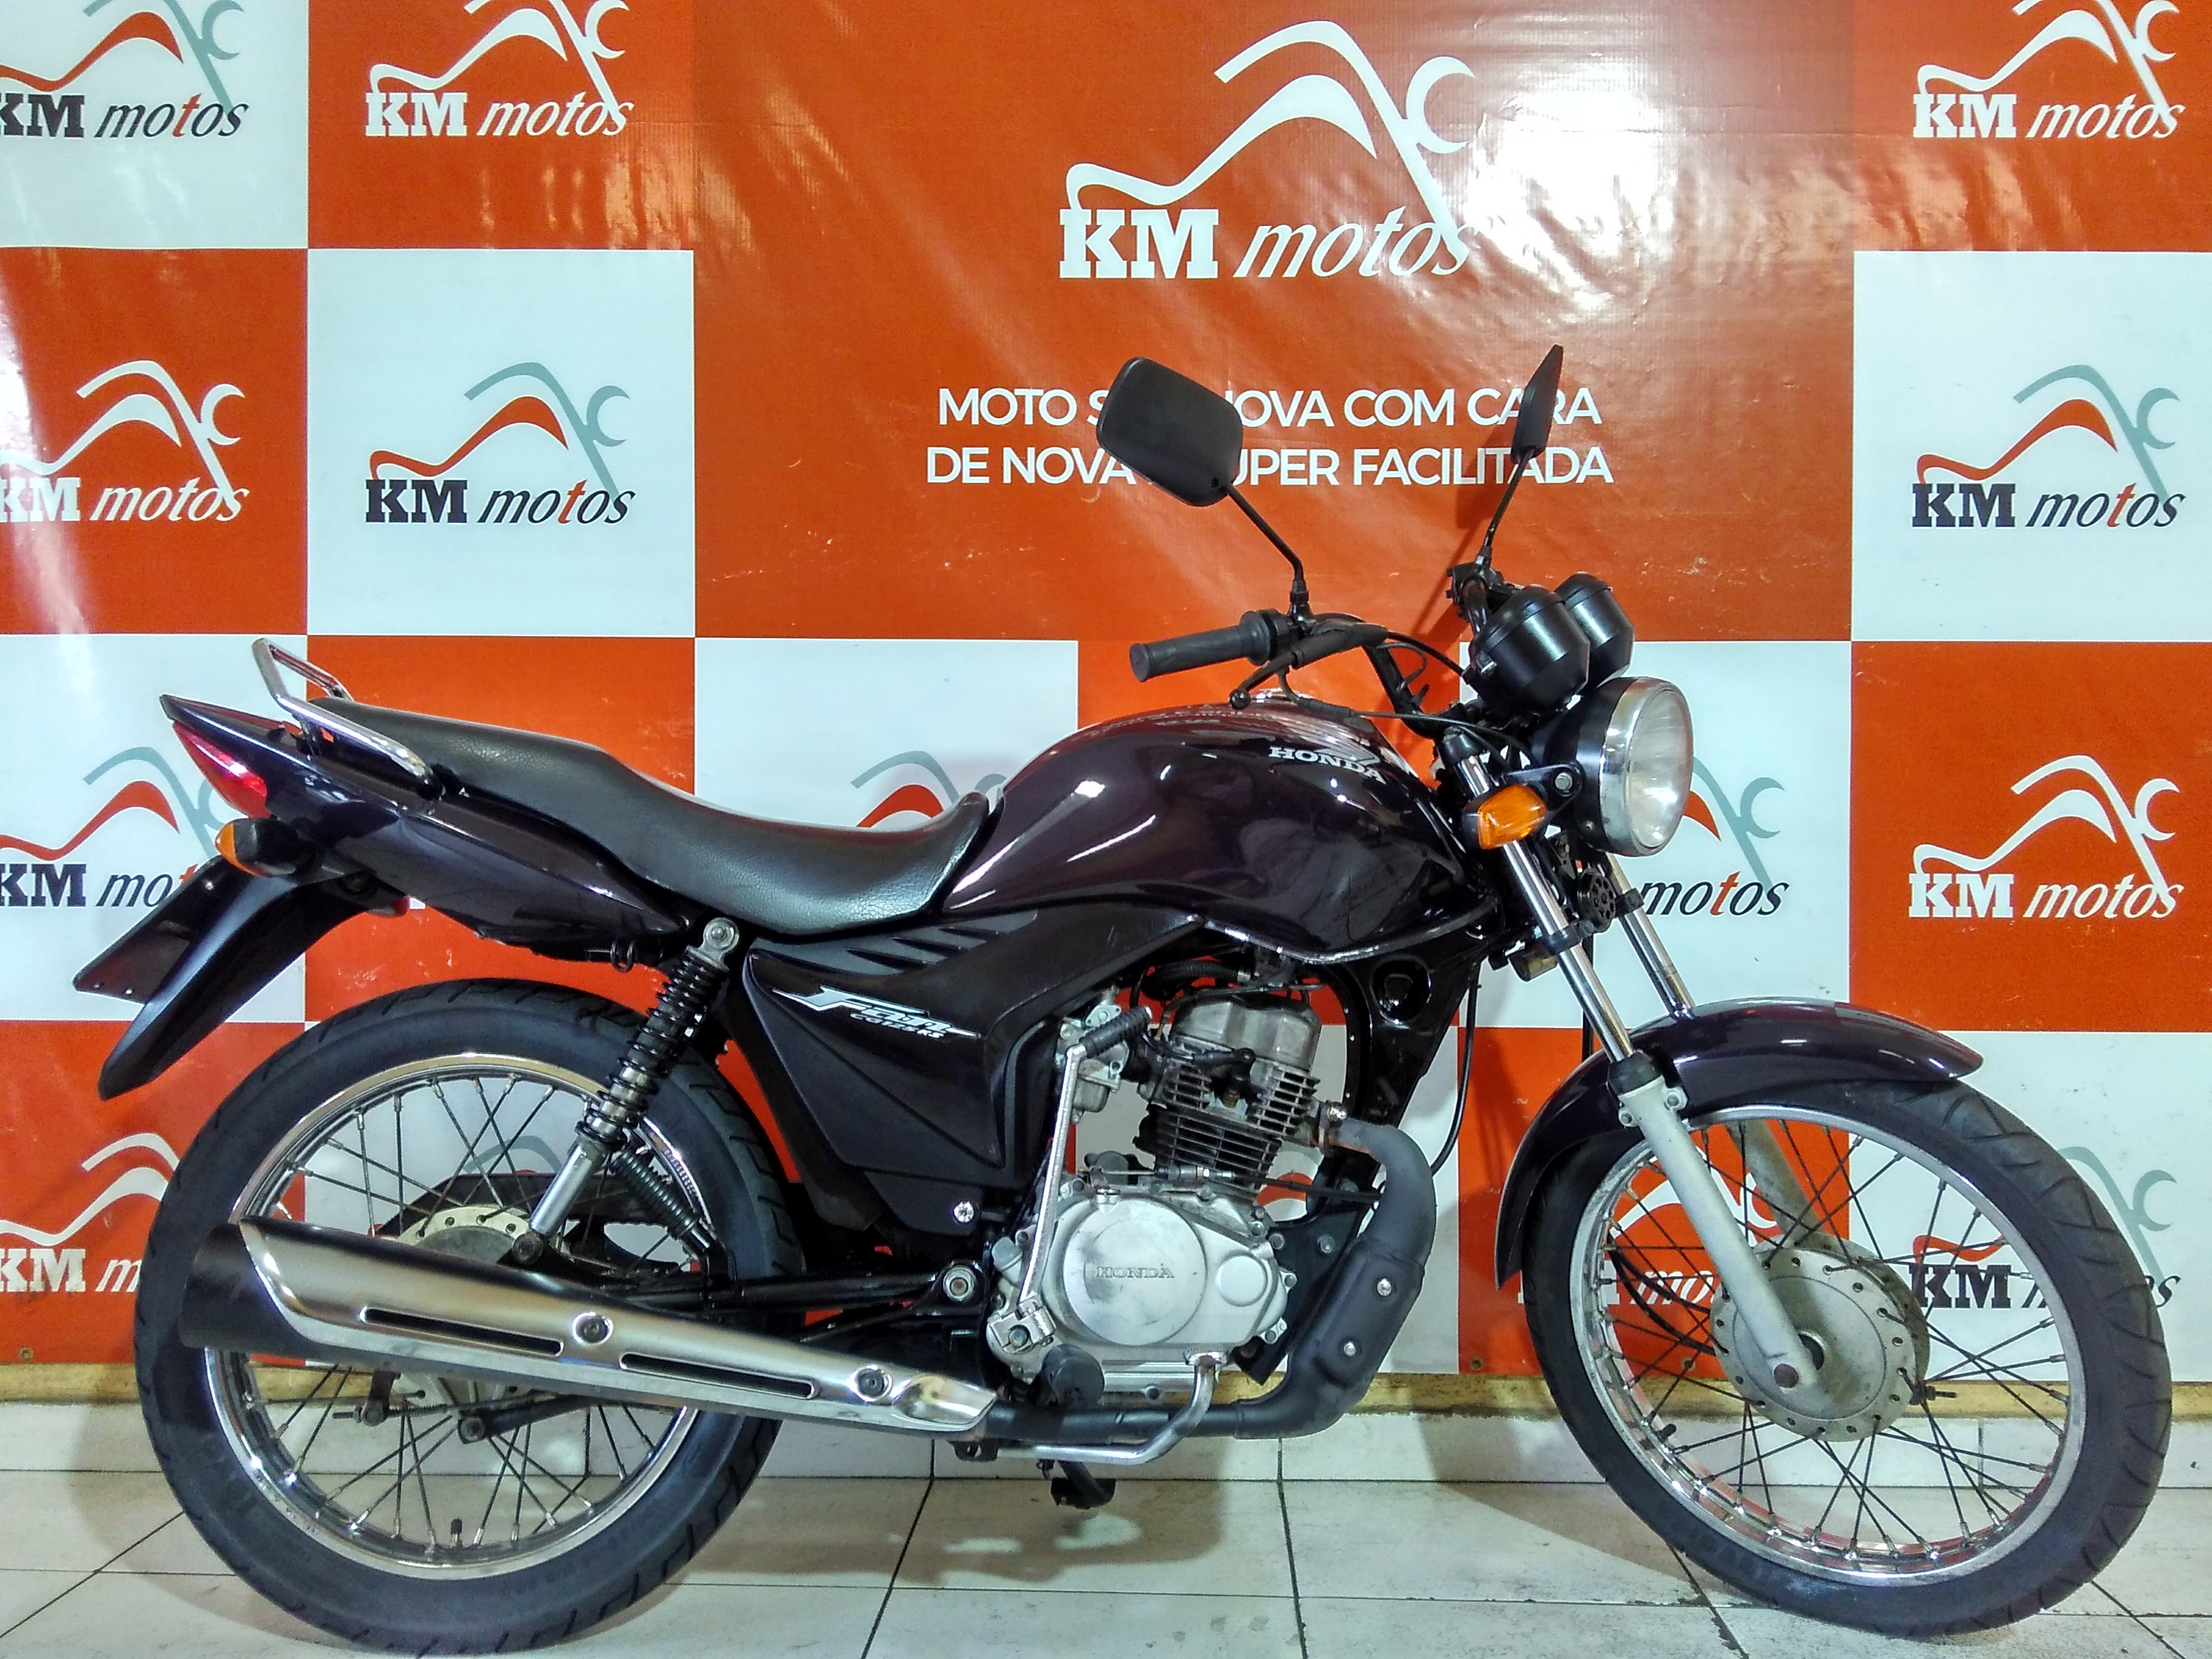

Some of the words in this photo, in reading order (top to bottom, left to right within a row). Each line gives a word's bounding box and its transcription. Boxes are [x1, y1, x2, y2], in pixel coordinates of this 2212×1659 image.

[94, 93, 250, 138] motos
[366, 93, 467, 135] KM
[477, 91, 635, 135] motos
[1913, 94, 2016, 138] KM
[2026, 94, 2185, 138] motos
[1060, 209, 1219, 278] KM
[1233, 206, 1478, 276] motos
[939, 388, 1077, 425] MOTO
[1344, 388, 1454, 427] COM
[927, 447, 989, 483] DE
[1004, 447, 1137, 484] NOVA
[1353, 447, 1614, 485] FACILITADA
[0, 478, 81, 521] KM
[89, 477, 250, 521] motos
[366, 480, 467, 523] KM
[477, 479, 635, 523] motos
[1912, 483, 2016, 527] KM
[2025, 482, 2185, 527] motos
[1268, 747, 1386, 785] HONDA
[1641, 871, 1790, 916] motos
[1909, 874, 2014, 917] KM
[2023, 874, 2184, 918] motos
[1096, 1266, 1174, 1278] HONDA
[1909, 1264, 2011, 1309] KM
